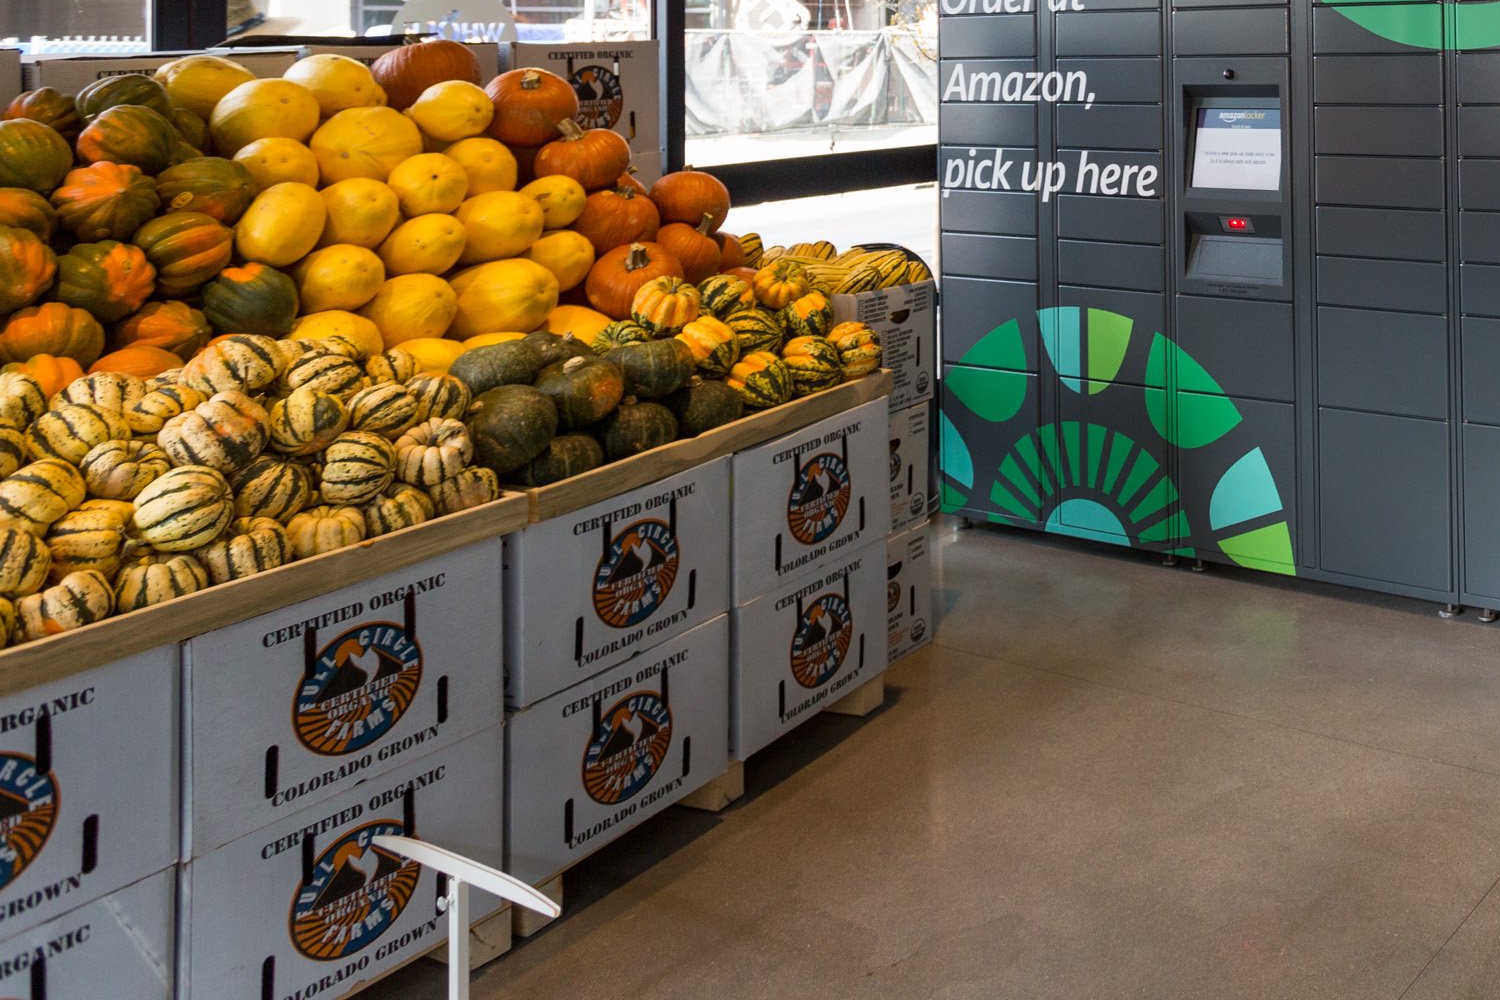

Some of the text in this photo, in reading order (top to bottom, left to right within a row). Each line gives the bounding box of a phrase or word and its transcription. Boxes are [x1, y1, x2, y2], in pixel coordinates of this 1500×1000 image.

[548, 50, 633, 60] CERTIFIED ORGANIC
[943, 63, 1095, 109] Amazon,
[943, 148, 1158, 202] pick up here
[773, 422, 861, 465] CERTIFIED ORGANIC
[573, 482, 696, 536] CERTIFIED ORGANIC
[637, 524, 676, 561] CIRCLE
[778, 530, 860, 576] COLORADO GROWN
[262, 573, 446, 649] CERTIFIED ORGANIC
[613, 584, 661, 616] FARMS
[775, 579, 823, 611] CERTIFIED
[358, 627, 419, 672] CIRCLE
[577, 608, 688, 668] COLORADO GROWN
[562, 649, 689, 718] CERTIFIED ORGANIC
[0, 687, 95, 733] RGANIC
[323, 699, 396, 741] FARMS
[0, 759, 53, 812] RCLE
[271, 724, 440, 807] COLORADO GROWN
[261, 766, 446, 859] CERTIFIED ORGANIC
[568, 776, 684, 849] COLORADO GROWN
[0, 874, 81, 920] ROWN
[0, 924, 90, 980] RGANIC
[375, 919, 437, 960] GROWN
